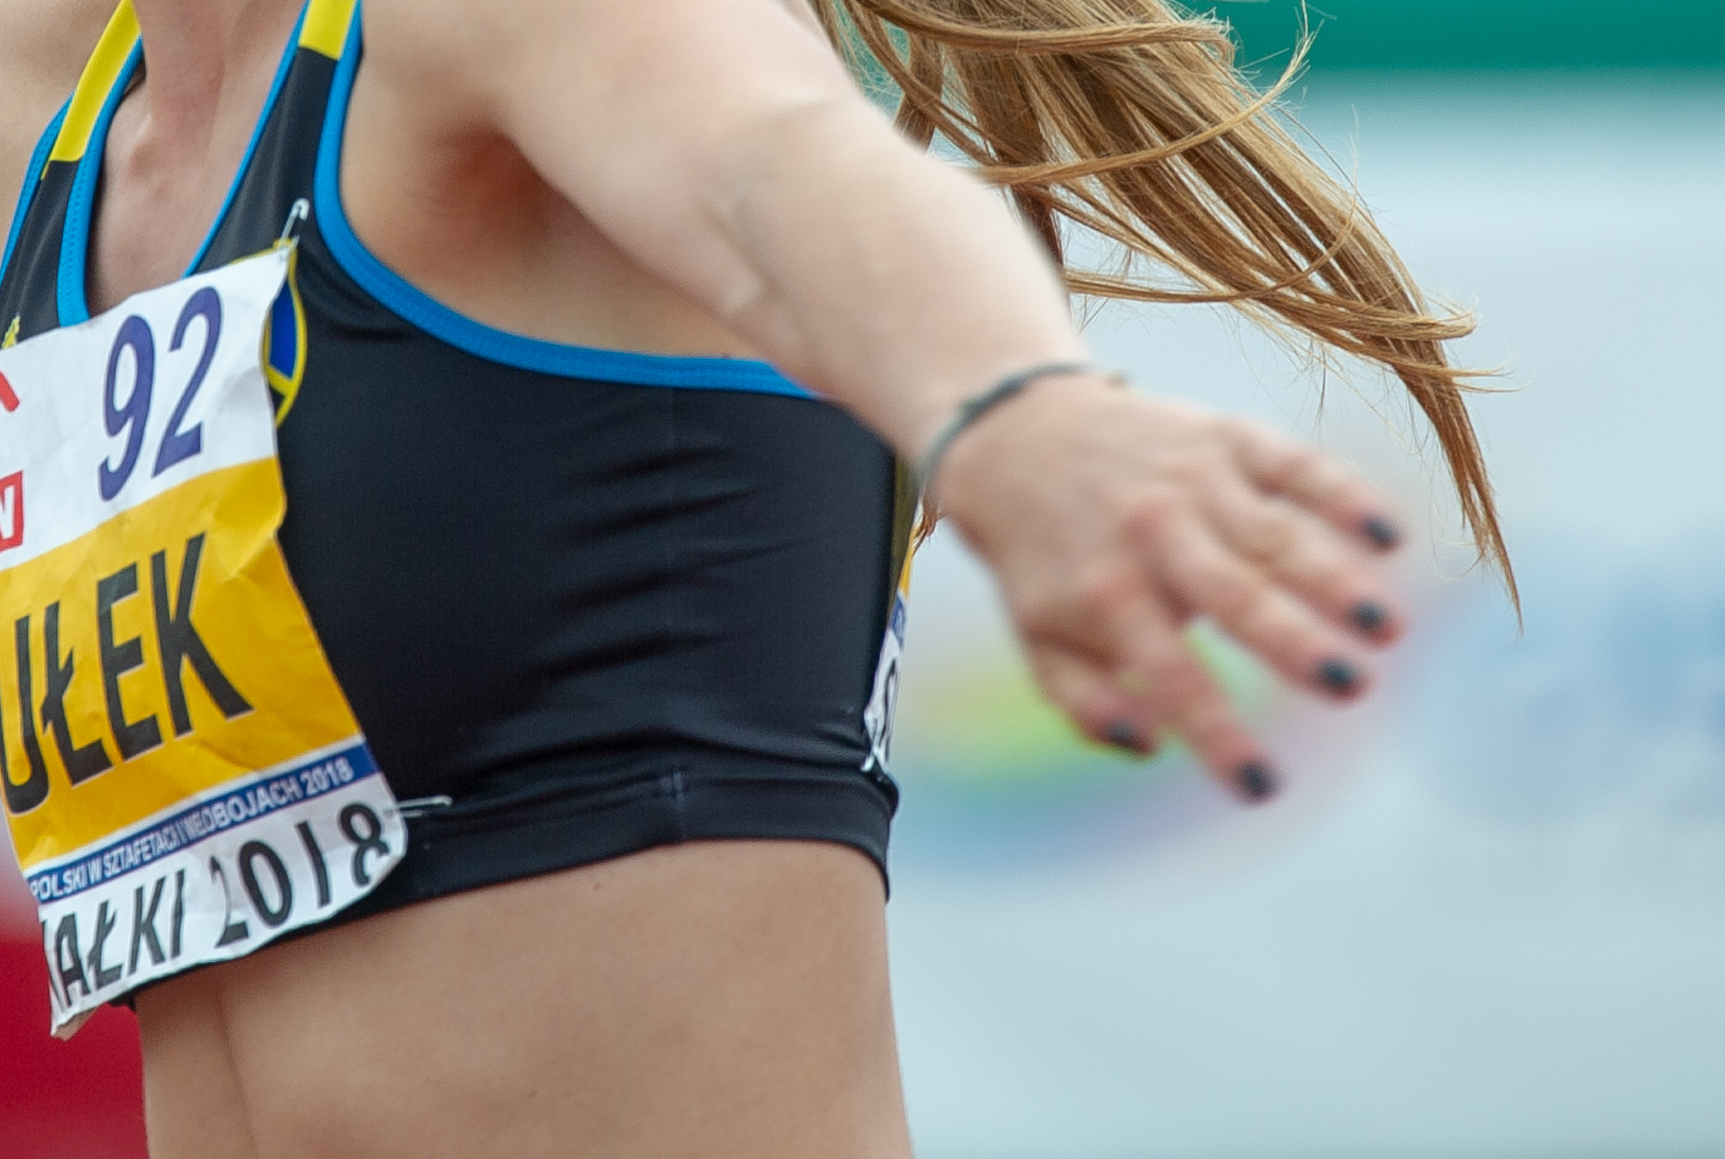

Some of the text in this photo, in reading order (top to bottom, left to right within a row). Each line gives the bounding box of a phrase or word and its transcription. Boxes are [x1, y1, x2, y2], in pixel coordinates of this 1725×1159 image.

[97, 285, 223, 503] 92
[87, 859, 103, 885] W
[300, 756, 355, 796] 2018
[209, 802, 390, 949] 2018
